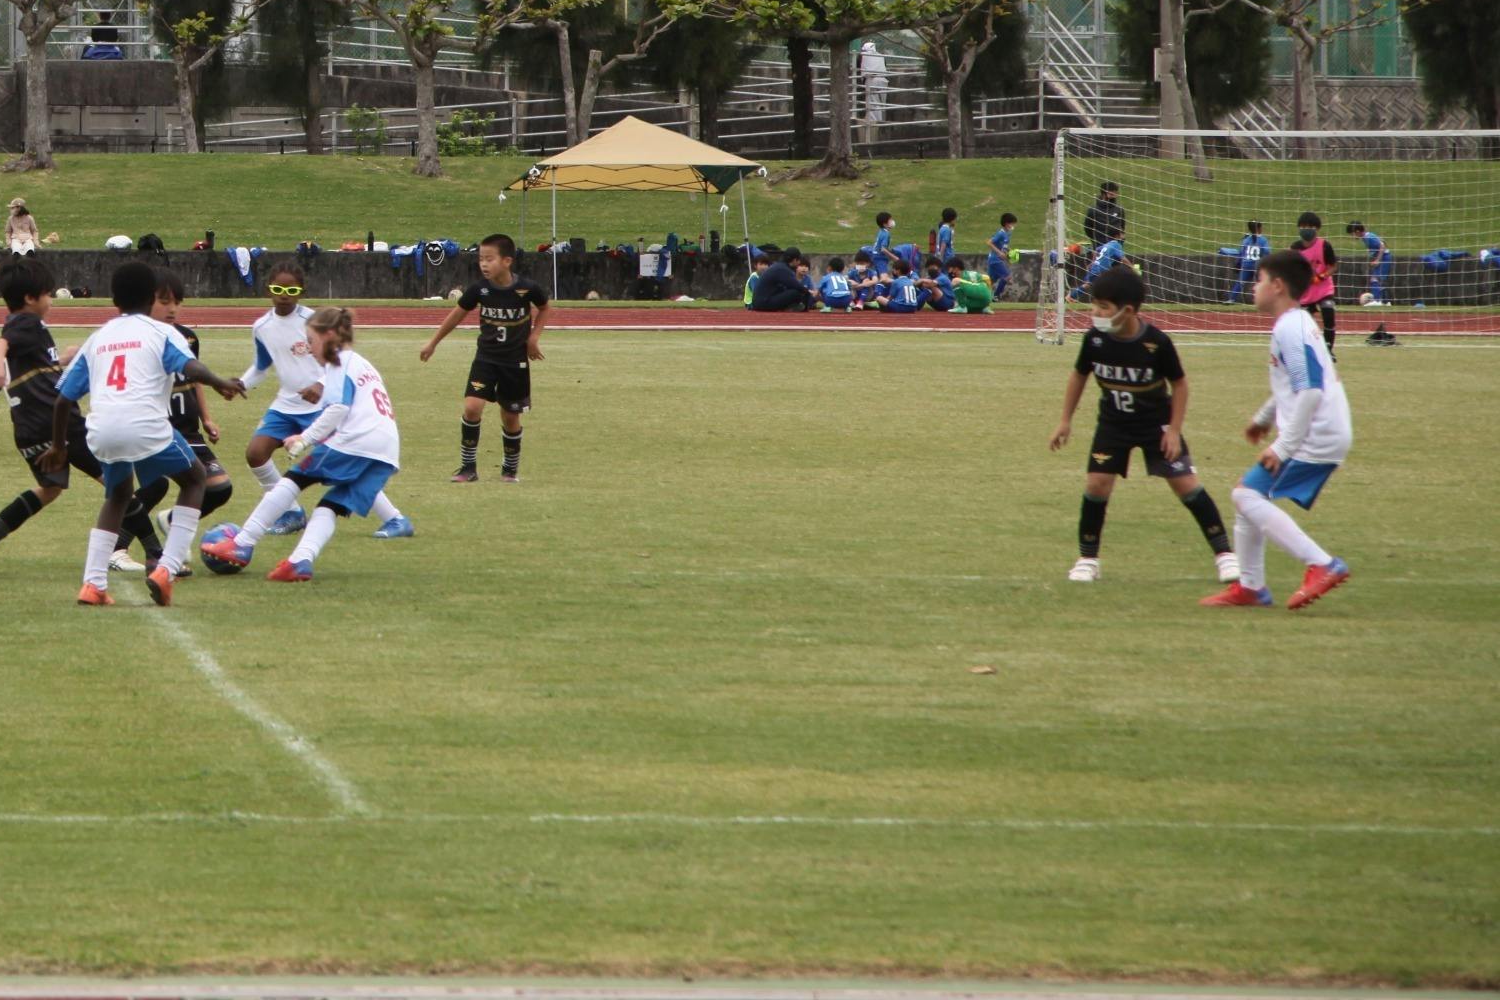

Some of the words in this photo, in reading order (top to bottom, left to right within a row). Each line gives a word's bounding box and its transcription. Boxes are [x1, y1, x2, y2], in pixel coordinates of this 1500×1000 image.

[1246, 245, 1260, 260] 10
[903, 285, 917, 304] 10
[481, 306, 525, 320] ZELVA
[496, 326, 507, 342] 3
[106, 354, 127, 391] 4
[1111, 390, 1135, 413] 12
